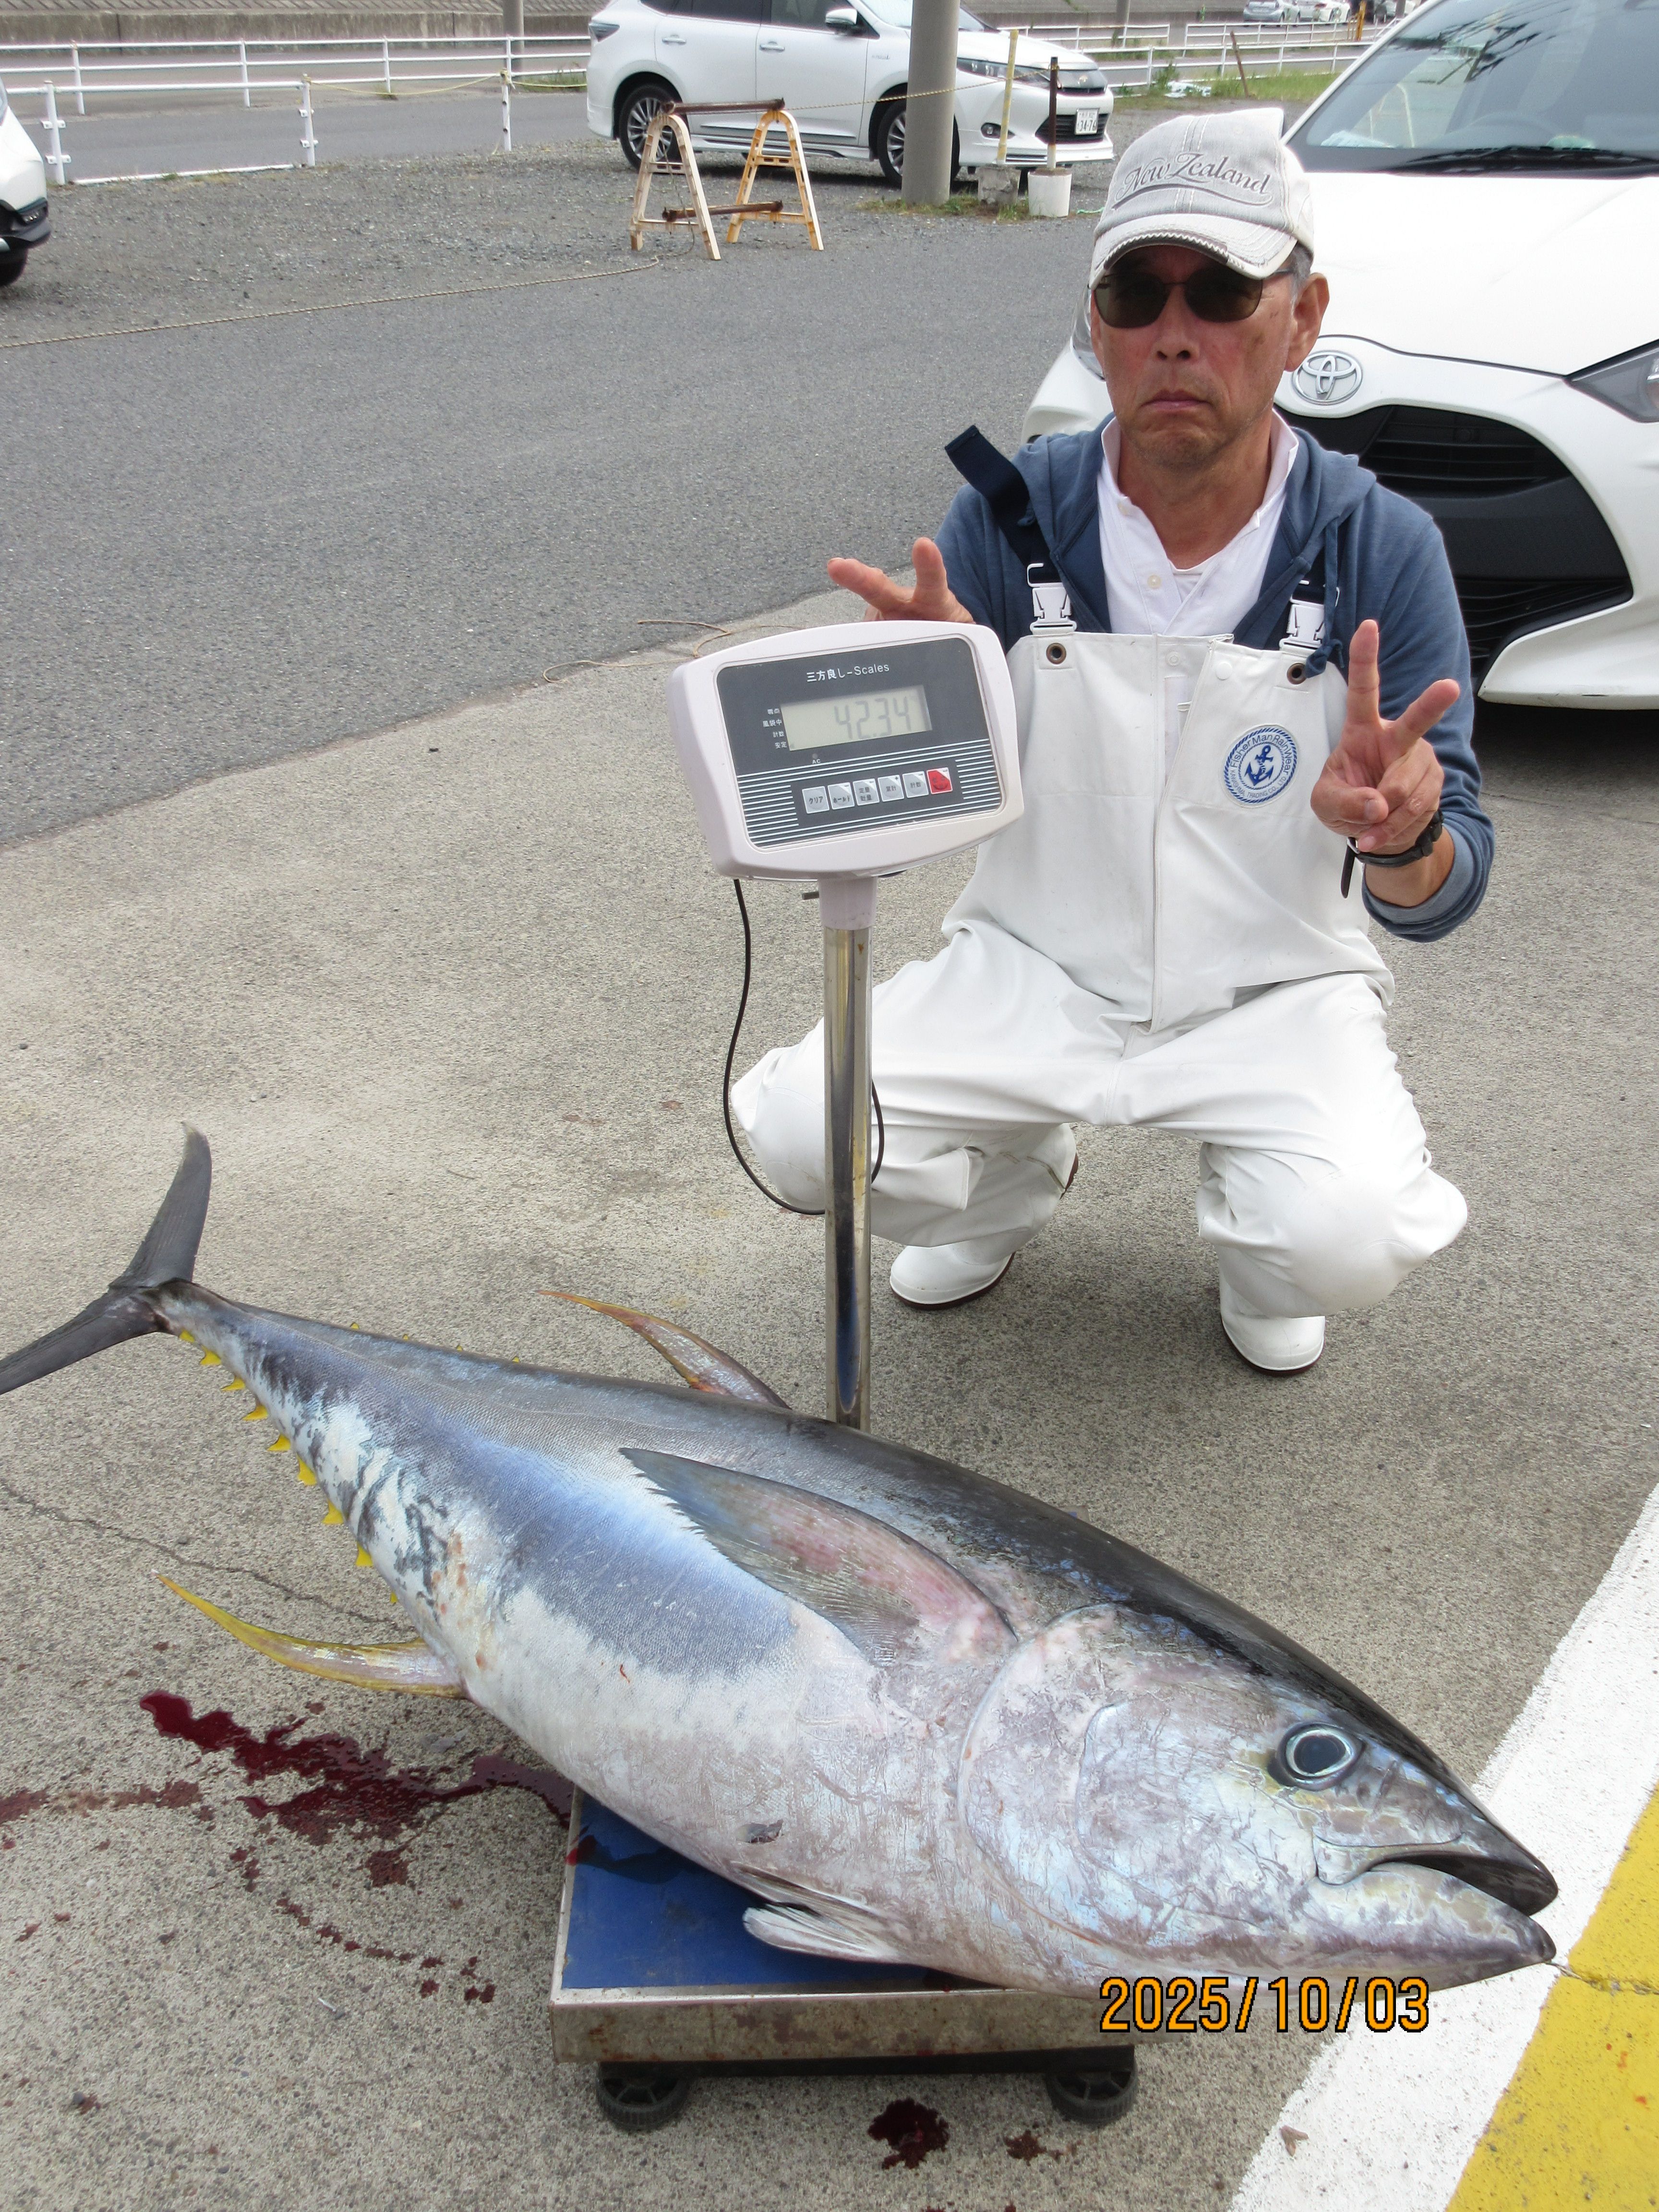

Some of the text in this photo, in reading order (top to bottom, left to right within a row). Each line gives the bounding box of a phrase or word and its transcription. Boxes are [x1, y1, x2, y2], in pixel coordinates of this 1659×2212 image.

[1116, 153, 1271, 198] New Zealand
[809, 796, 823, 805] クリア
